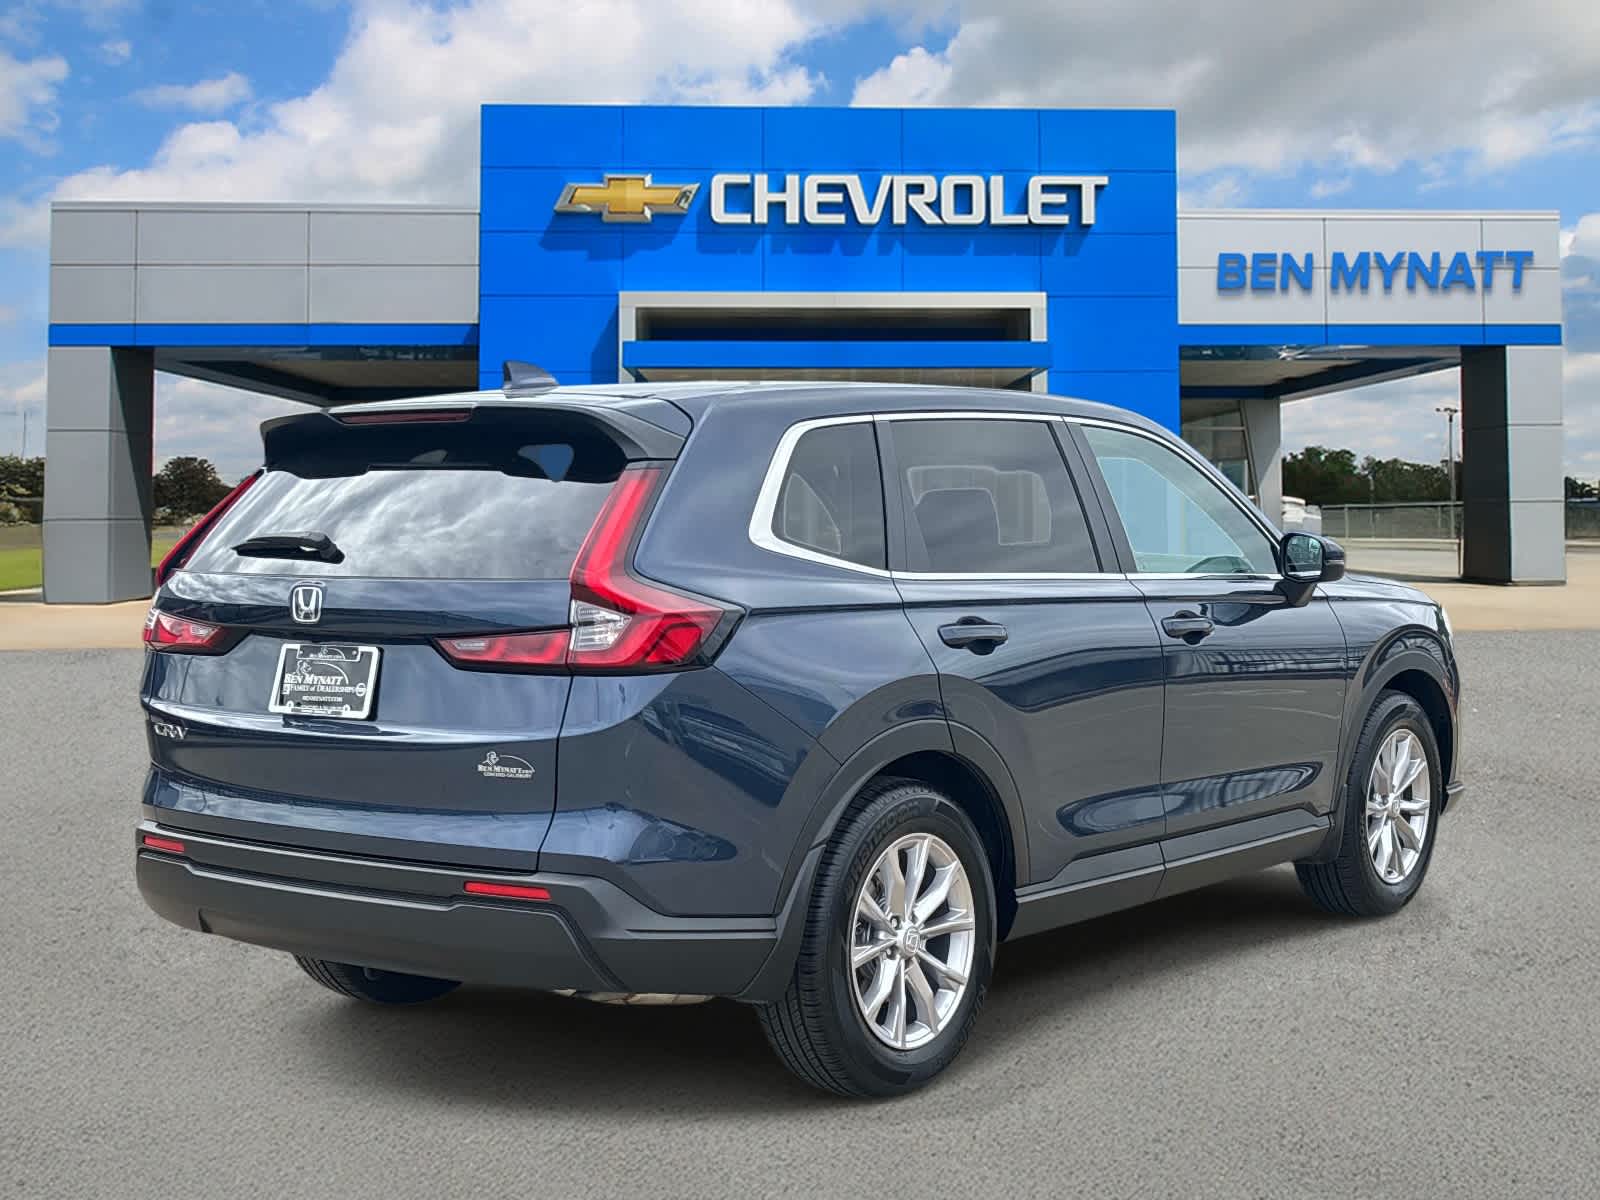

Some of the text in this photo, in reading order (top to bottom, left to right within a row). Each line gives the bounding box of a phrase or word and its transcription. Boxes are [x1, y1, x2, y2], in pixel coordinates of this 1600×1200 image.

[710, 174, 1109, 225] CHEVROLET
[1217, 250, 1534, 290] BEN MYNATT
